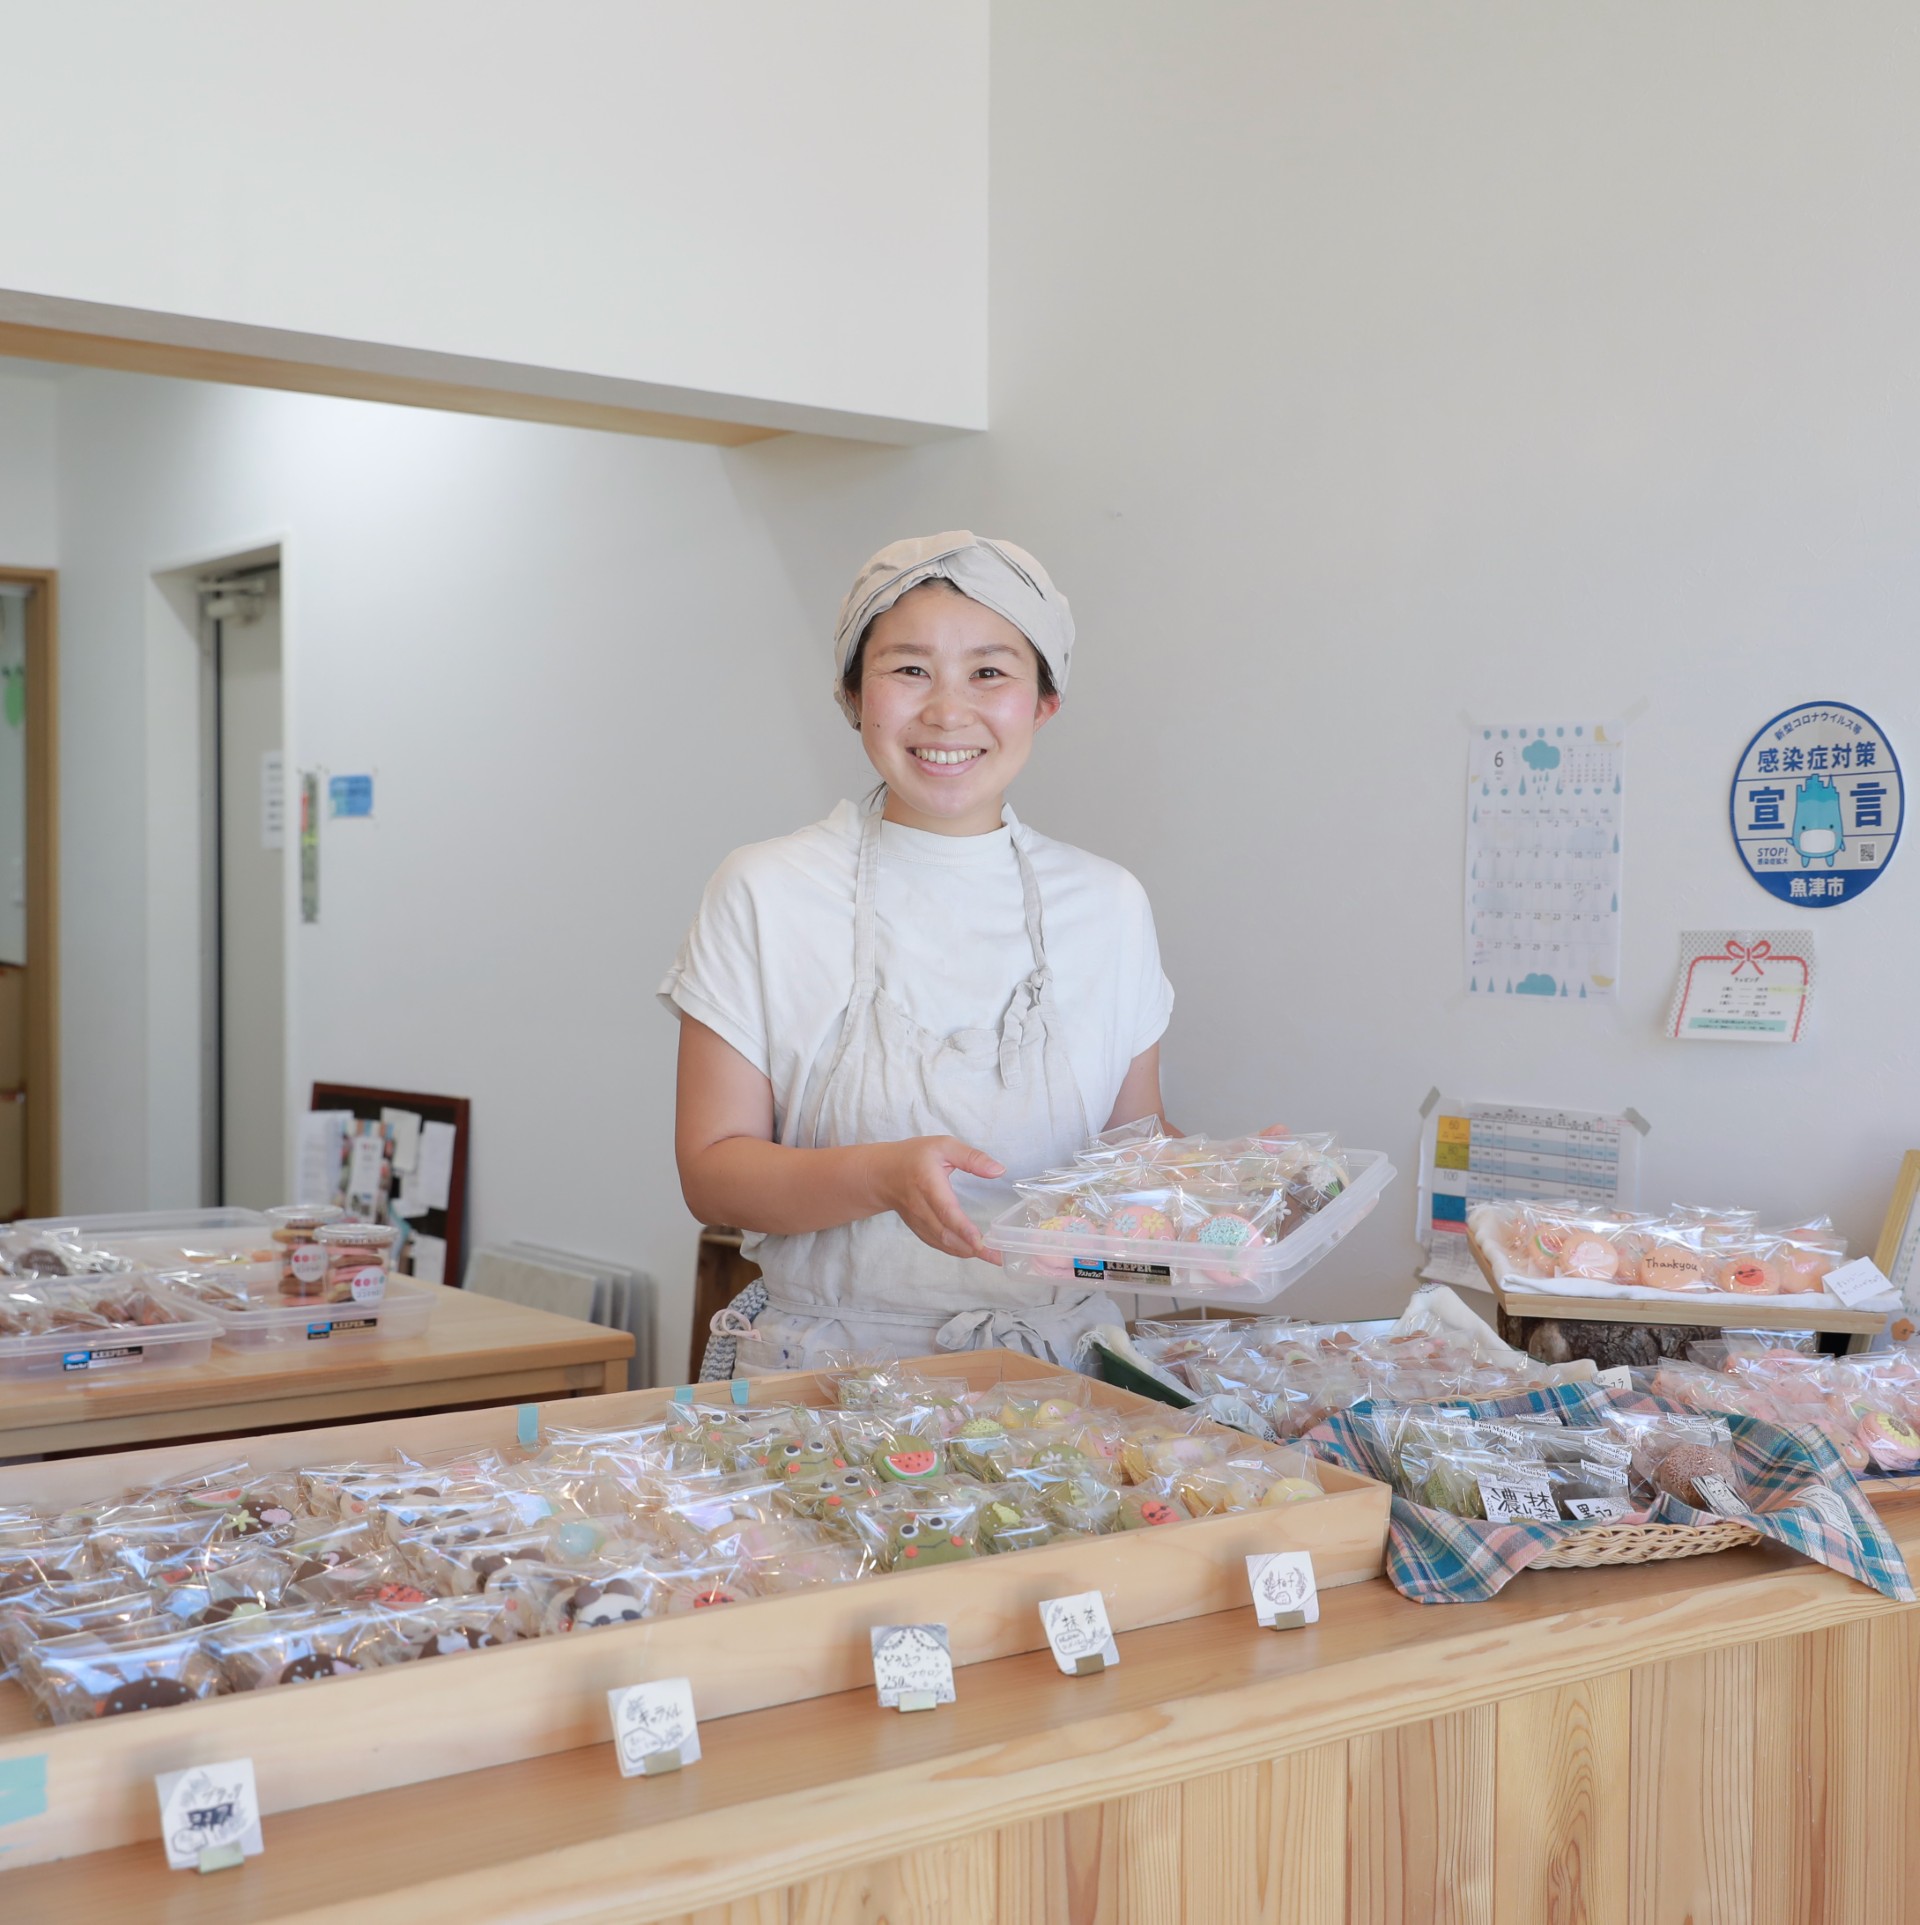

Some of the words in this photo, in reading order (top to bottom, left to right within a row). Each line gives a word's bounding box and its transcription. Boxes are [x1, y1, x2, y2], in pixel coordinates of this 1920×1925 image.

[1774, 711, 1863, 741] 新型コロナウイルス等
[1494, 751, 1504, 768] 6
[1757, 741, 1876, 773] 感染症対策
[1748, 786, 1785, 831] 宣
[1850, 782, 1887, 828] 言
[1757, 847, 1788, 857] STOP!
[1789, 876, 1845, 898] 魚津市
[1107, 1261, 1152, 1273] KEEPER
[332, 1320, 364, 1330] KEEPER
[91, 1348, 129, 1360] KEEPER
[1062, 1606, 1096, 1632] 抹茶
[883, 1653, 921, 1668] どうぶつ
[639, 1702, 683, 1728] キャラメル
